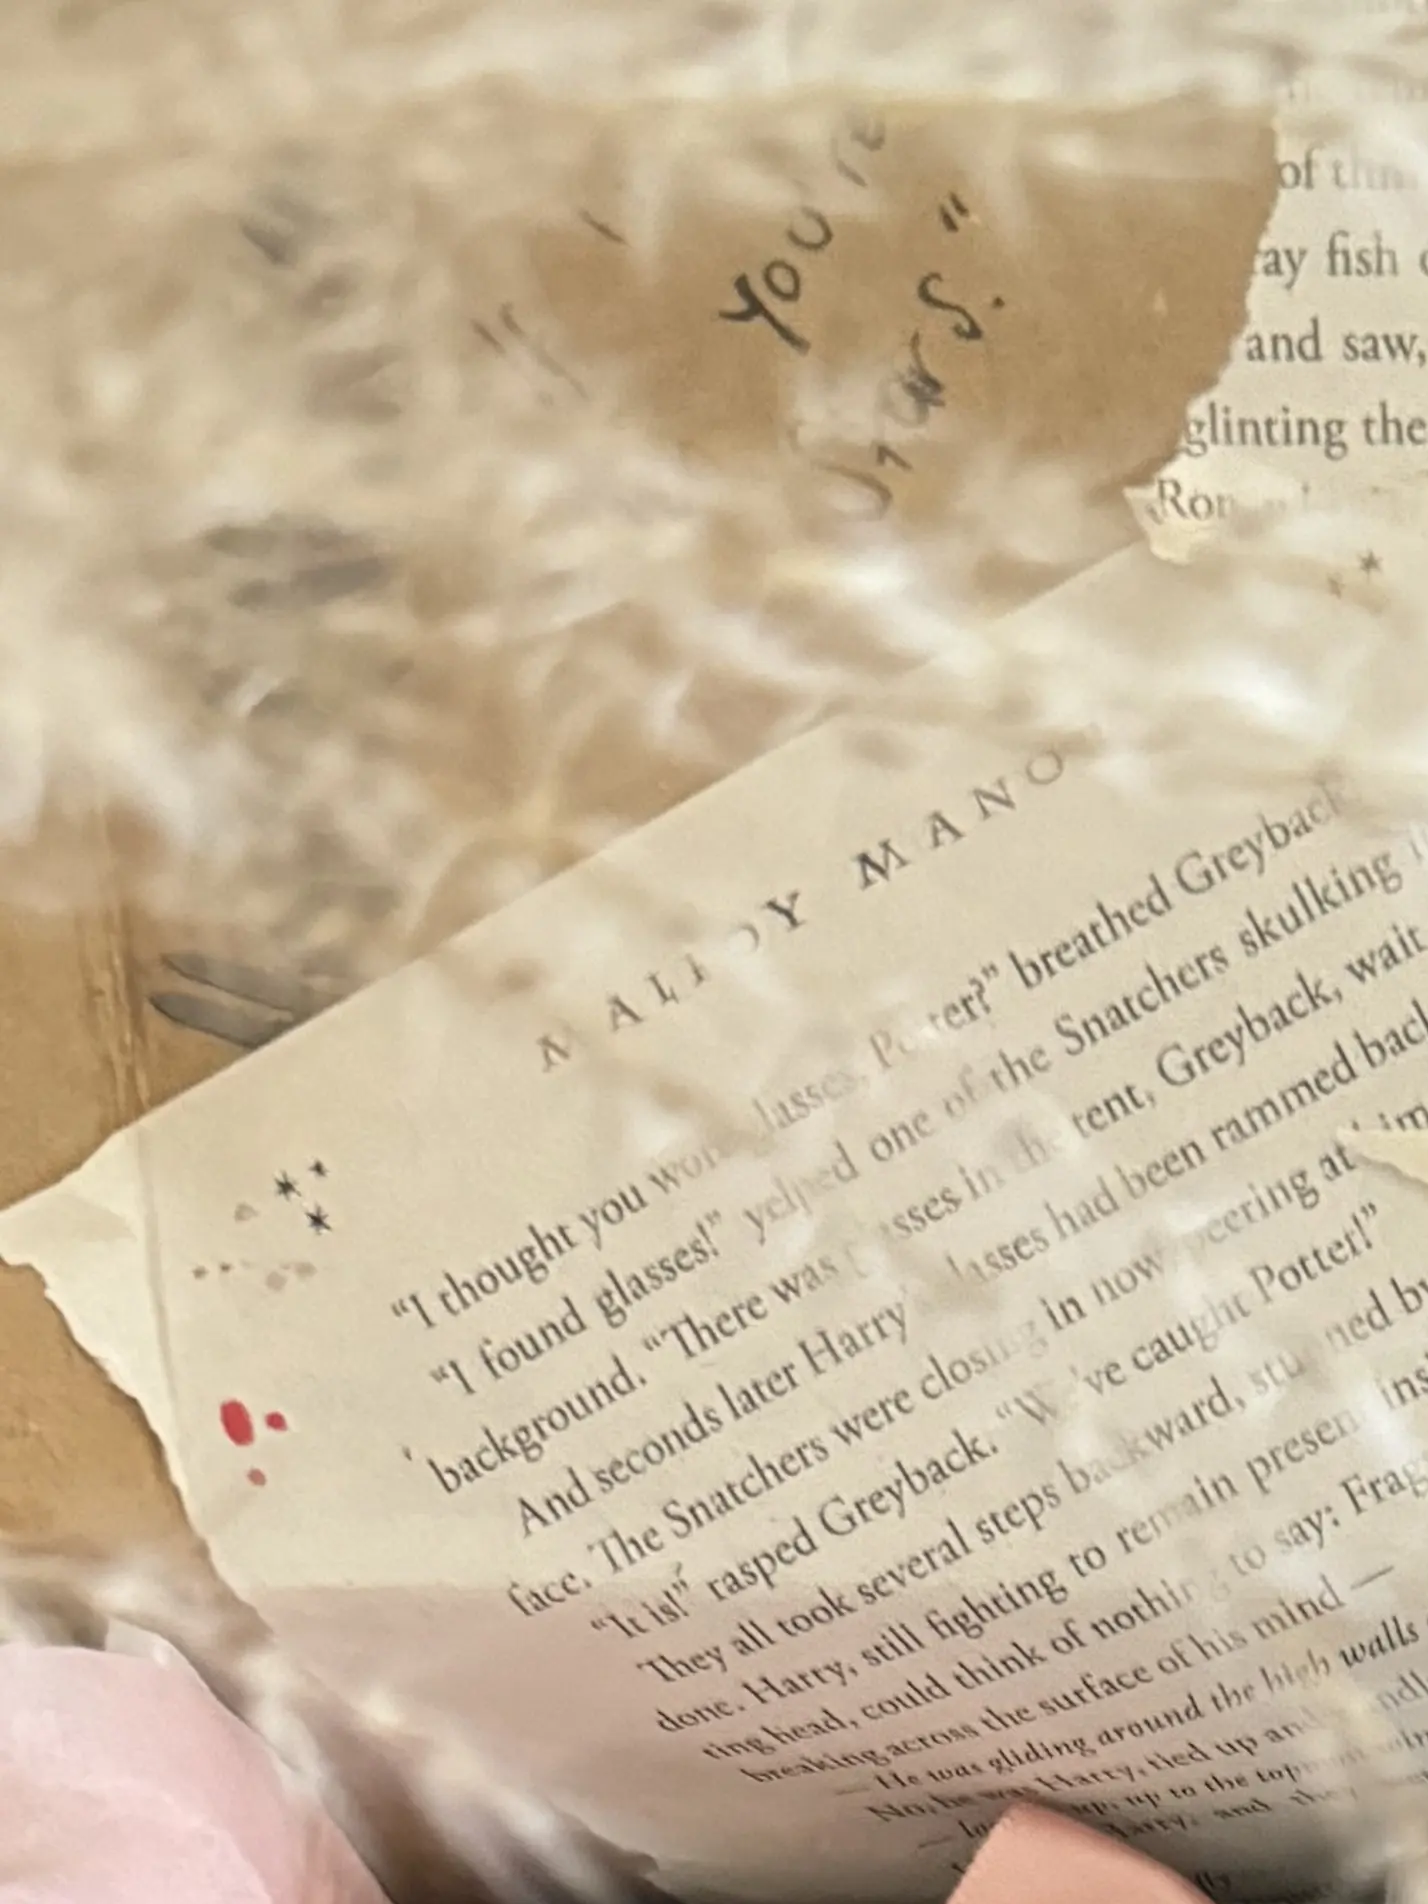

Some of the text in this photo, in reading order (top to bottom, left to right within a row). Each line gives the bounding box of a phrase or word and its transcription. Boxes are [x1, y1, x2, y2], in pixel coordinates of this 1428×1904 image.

[1324, 227, 1400, 279] fish
[1243, 314, 1325, 364] and
[1340, 330, 1428, 369] saw,
[1181, 388, 1350, 462] glinting
[1069, 925, 1428, 1139] tent, Greyback, wait
[389, 1182, 650, 1330] "I thought you
[427, 1213, 720, 1396] "I found glasses!"
[515, 1360, 800, 1539] And seconds later
[642, 1483, 1062, 1684] They all took several steps
